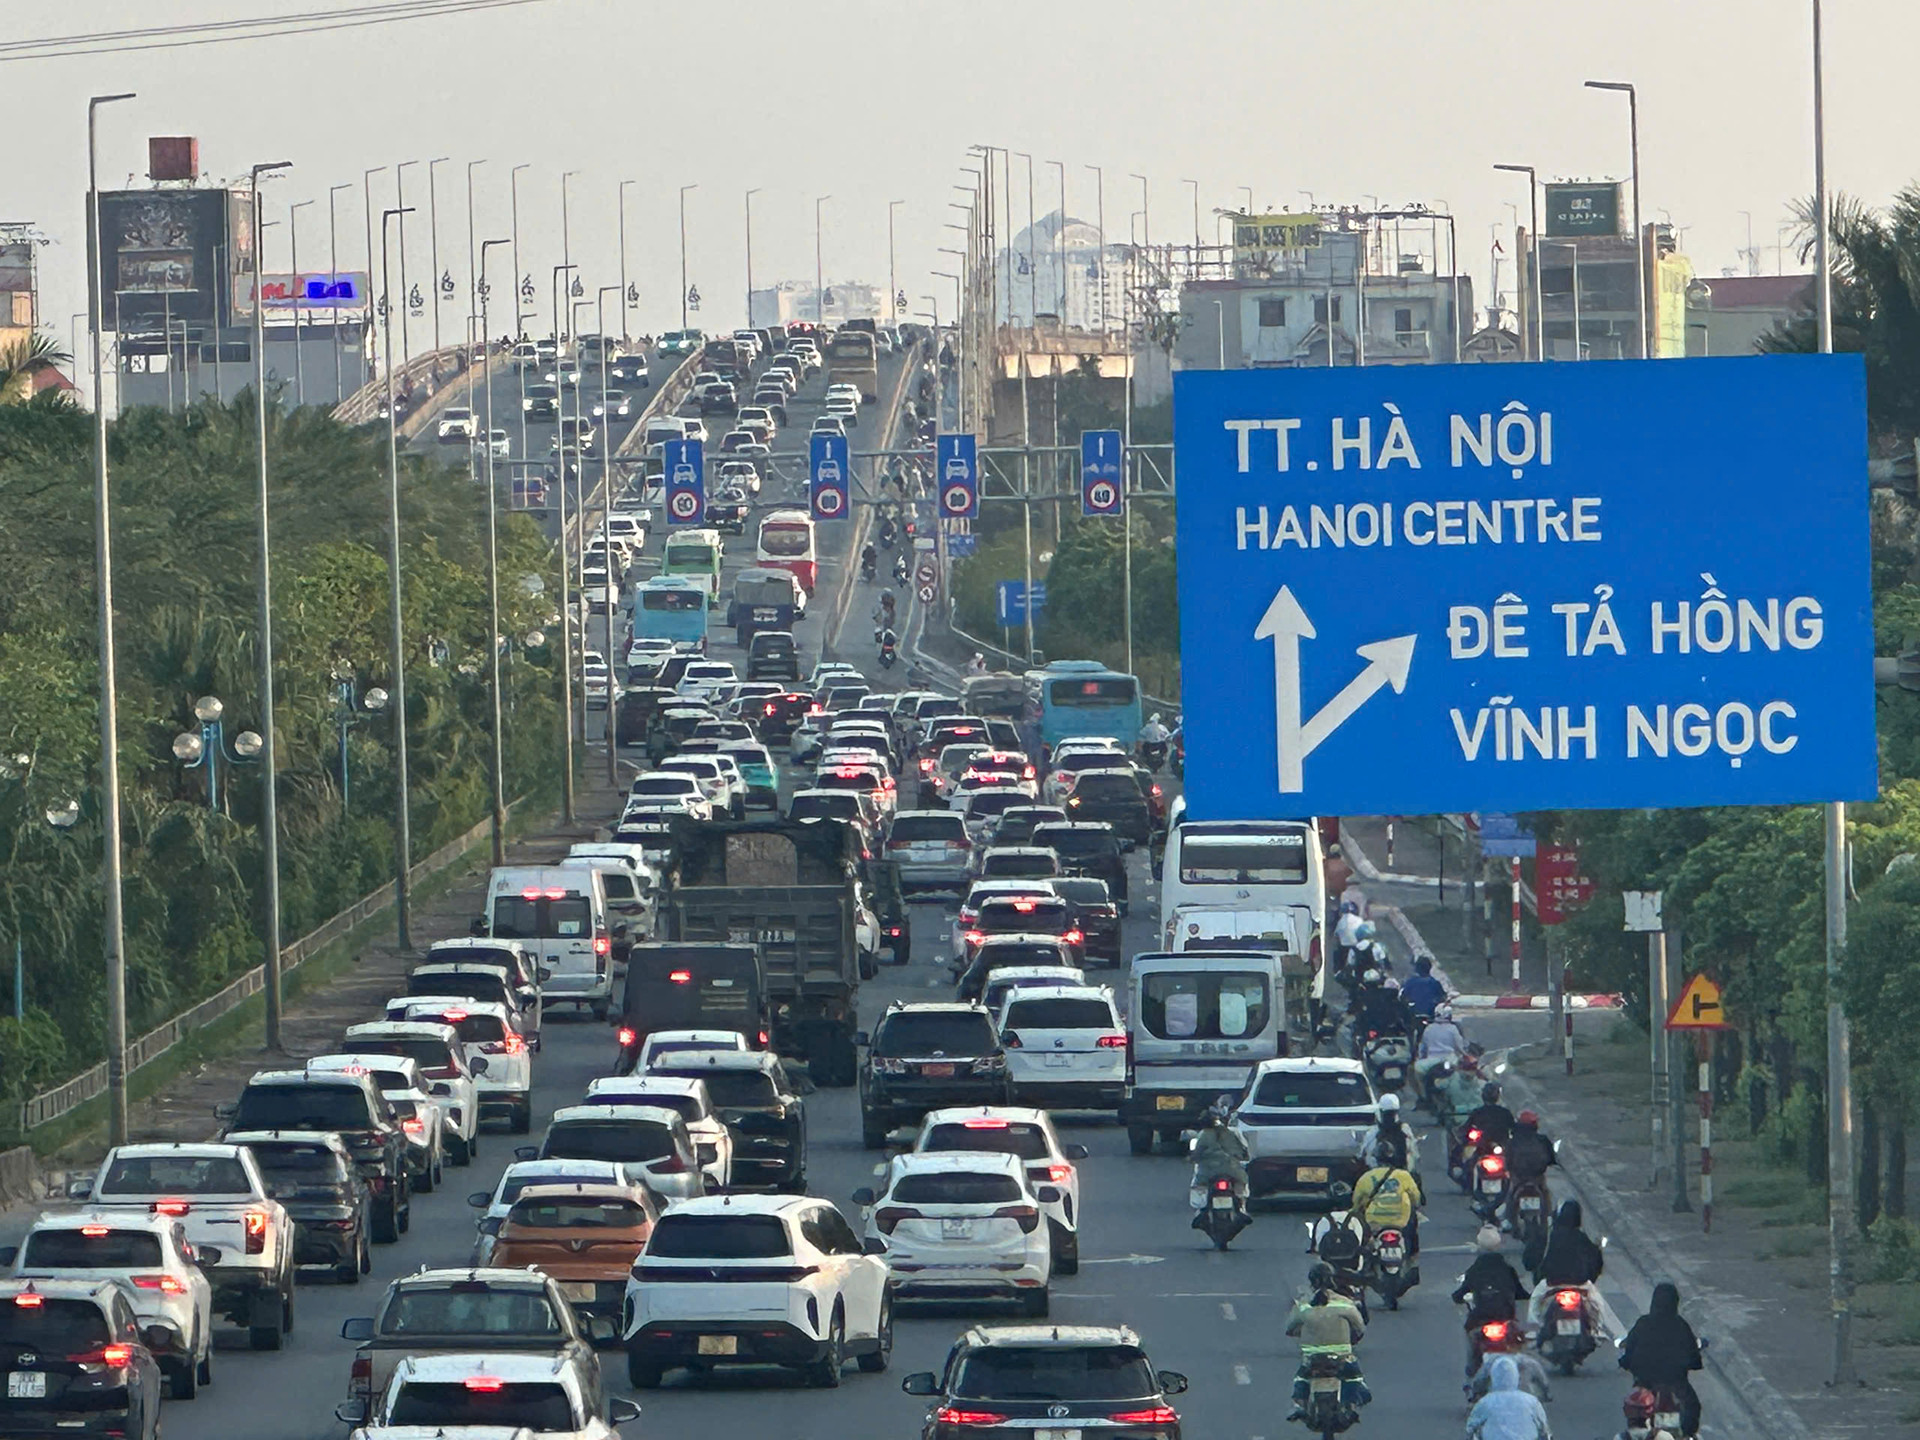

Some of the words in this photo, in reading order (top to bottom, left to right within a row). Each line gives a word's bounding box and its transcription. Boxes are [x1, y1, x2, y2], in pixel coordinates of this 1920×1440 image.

[1451, 401, 1551, 479] NỘI
[1237, 503, 1392, 550] HANOI
[1404, 498, 1601, 546] CENTRE
[1447, 593, 1528, 660] ĐÊ
[1552, 584, 1626, 657] TẢ
[1652, 573, 1823, 654] HỒNG
[1450, 696, 1596, 760] VĨNH
[1627, 702, 1797, 767] NGỌC
